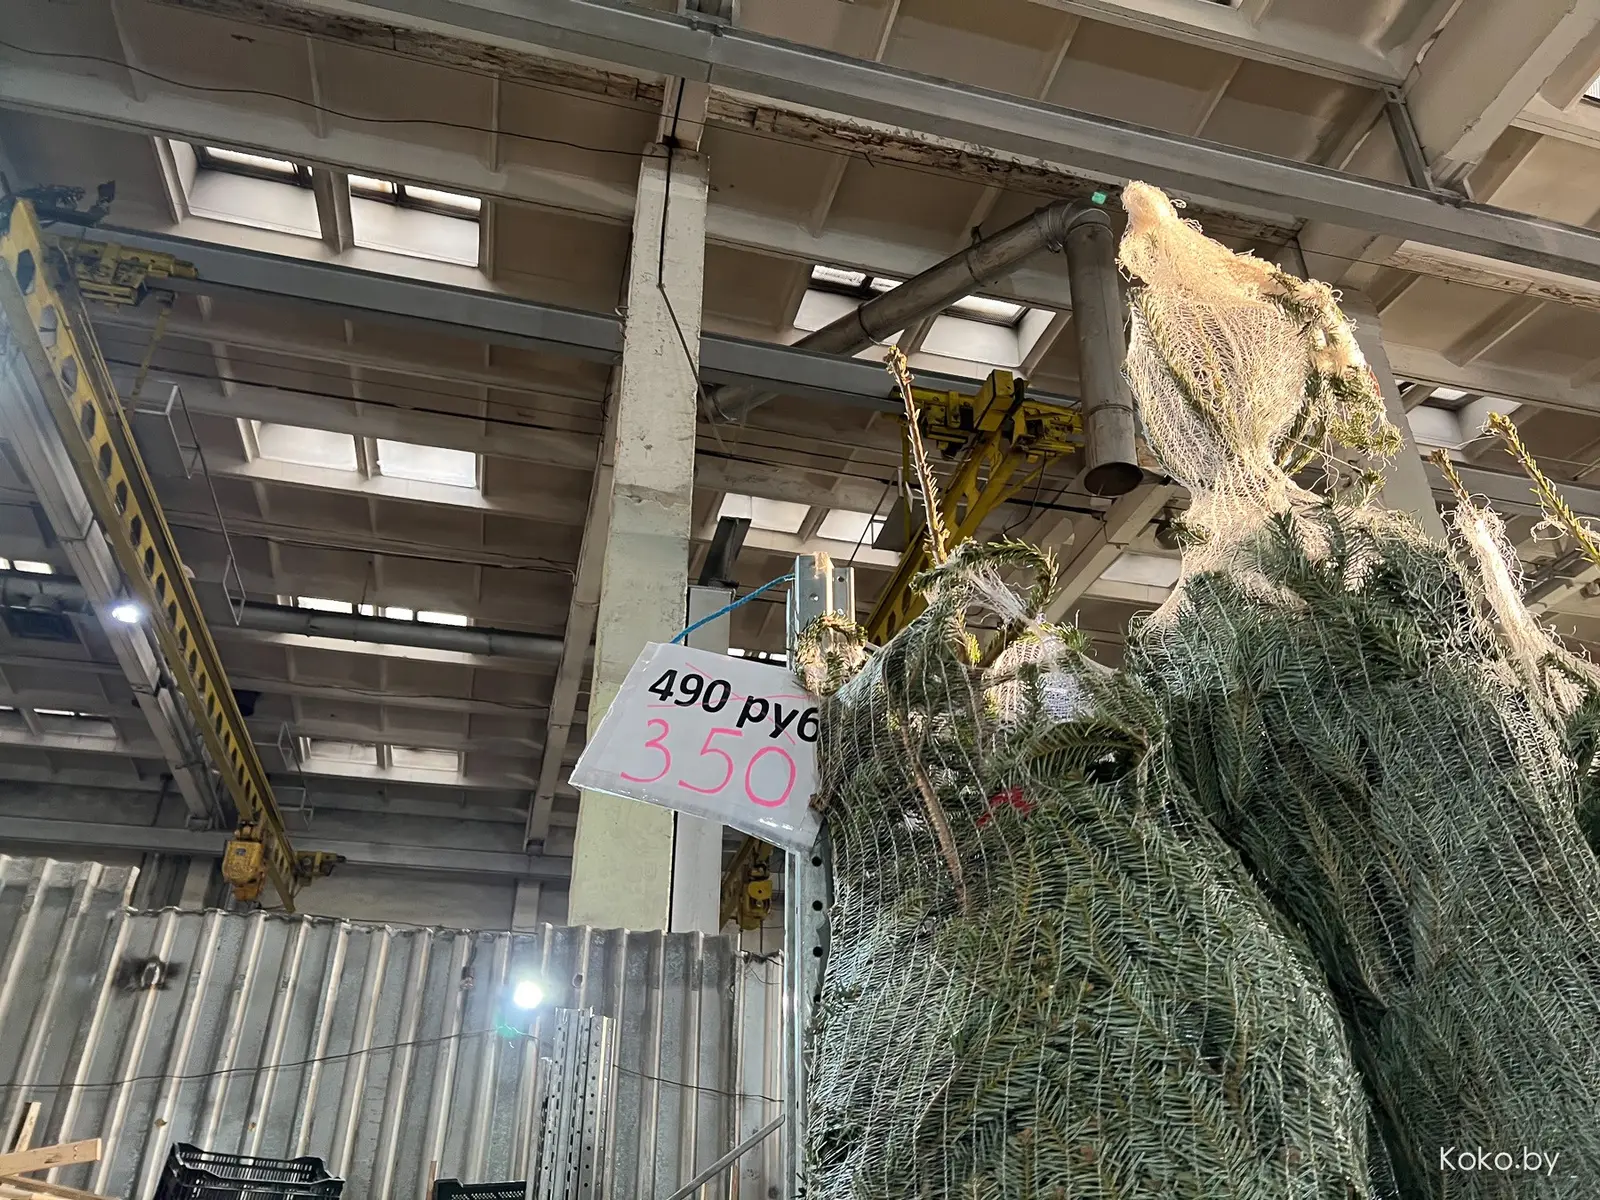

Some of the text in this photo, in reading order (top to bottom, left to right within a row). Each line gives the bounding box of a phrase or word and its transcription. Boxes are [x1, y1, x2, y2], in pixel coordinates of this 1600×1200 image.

[648, 669, 819, 742] 490 руб
[620, 718, 796, 808] 350
